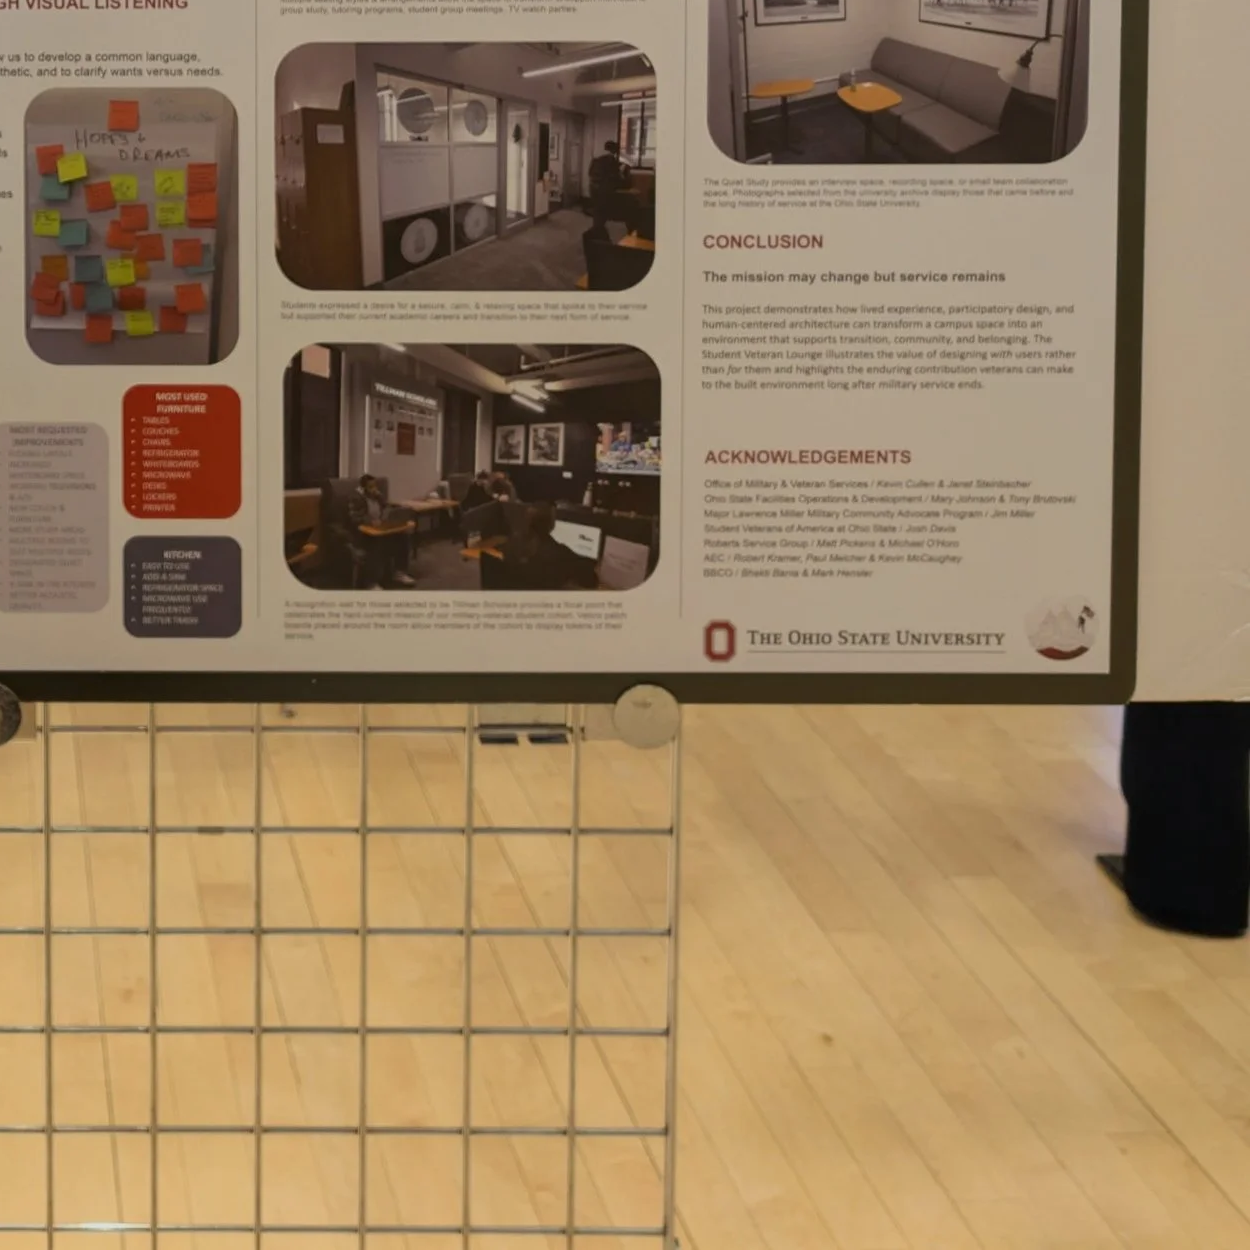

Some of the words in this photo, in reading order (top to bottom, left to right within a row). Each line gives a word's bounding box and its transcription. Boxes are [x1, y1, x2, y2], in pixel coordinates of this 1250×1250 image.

[7, 53, 21, 62] us
[24, 52, 35, 62] to
[37, 51, 82, 63] develop
[84, 53, 92, 61] a
[94, 53, 143, 62] common
[36, 66, 57, 77] and
[60, 66, 71, 76] to
[74, 65, 107, 78] clarify
[110, 67, 143, 76] wants
[146, 67, 183, 76] versus
[702, 233, 823, 249] CONCLUSION
[702, 270, 727, 282] The
[731, 270, 784, 282] mission
[788, 273, 816, 285] may
[820, 270, 870, 284] change
[873, 270, 895, 282] but
[899, 271, 948, 282] service
[951, 270, 1005, 282] remains
[702, 303, 722, 314] This
[725, 304, 760, 315] project
[763, 304, 833, 314] demonstrates
[835, 304, 857, 314] how
[860, 304, 884, 314] lived
[886, 304, 945, 315] experience,
[948, 304, 1013, 315] participatory
[1016, 303, 1051, 315] design,
[1055, 304, 1074, 313] and
[704, 448, 911, 464] ACKNOWLEDGEMENTS
